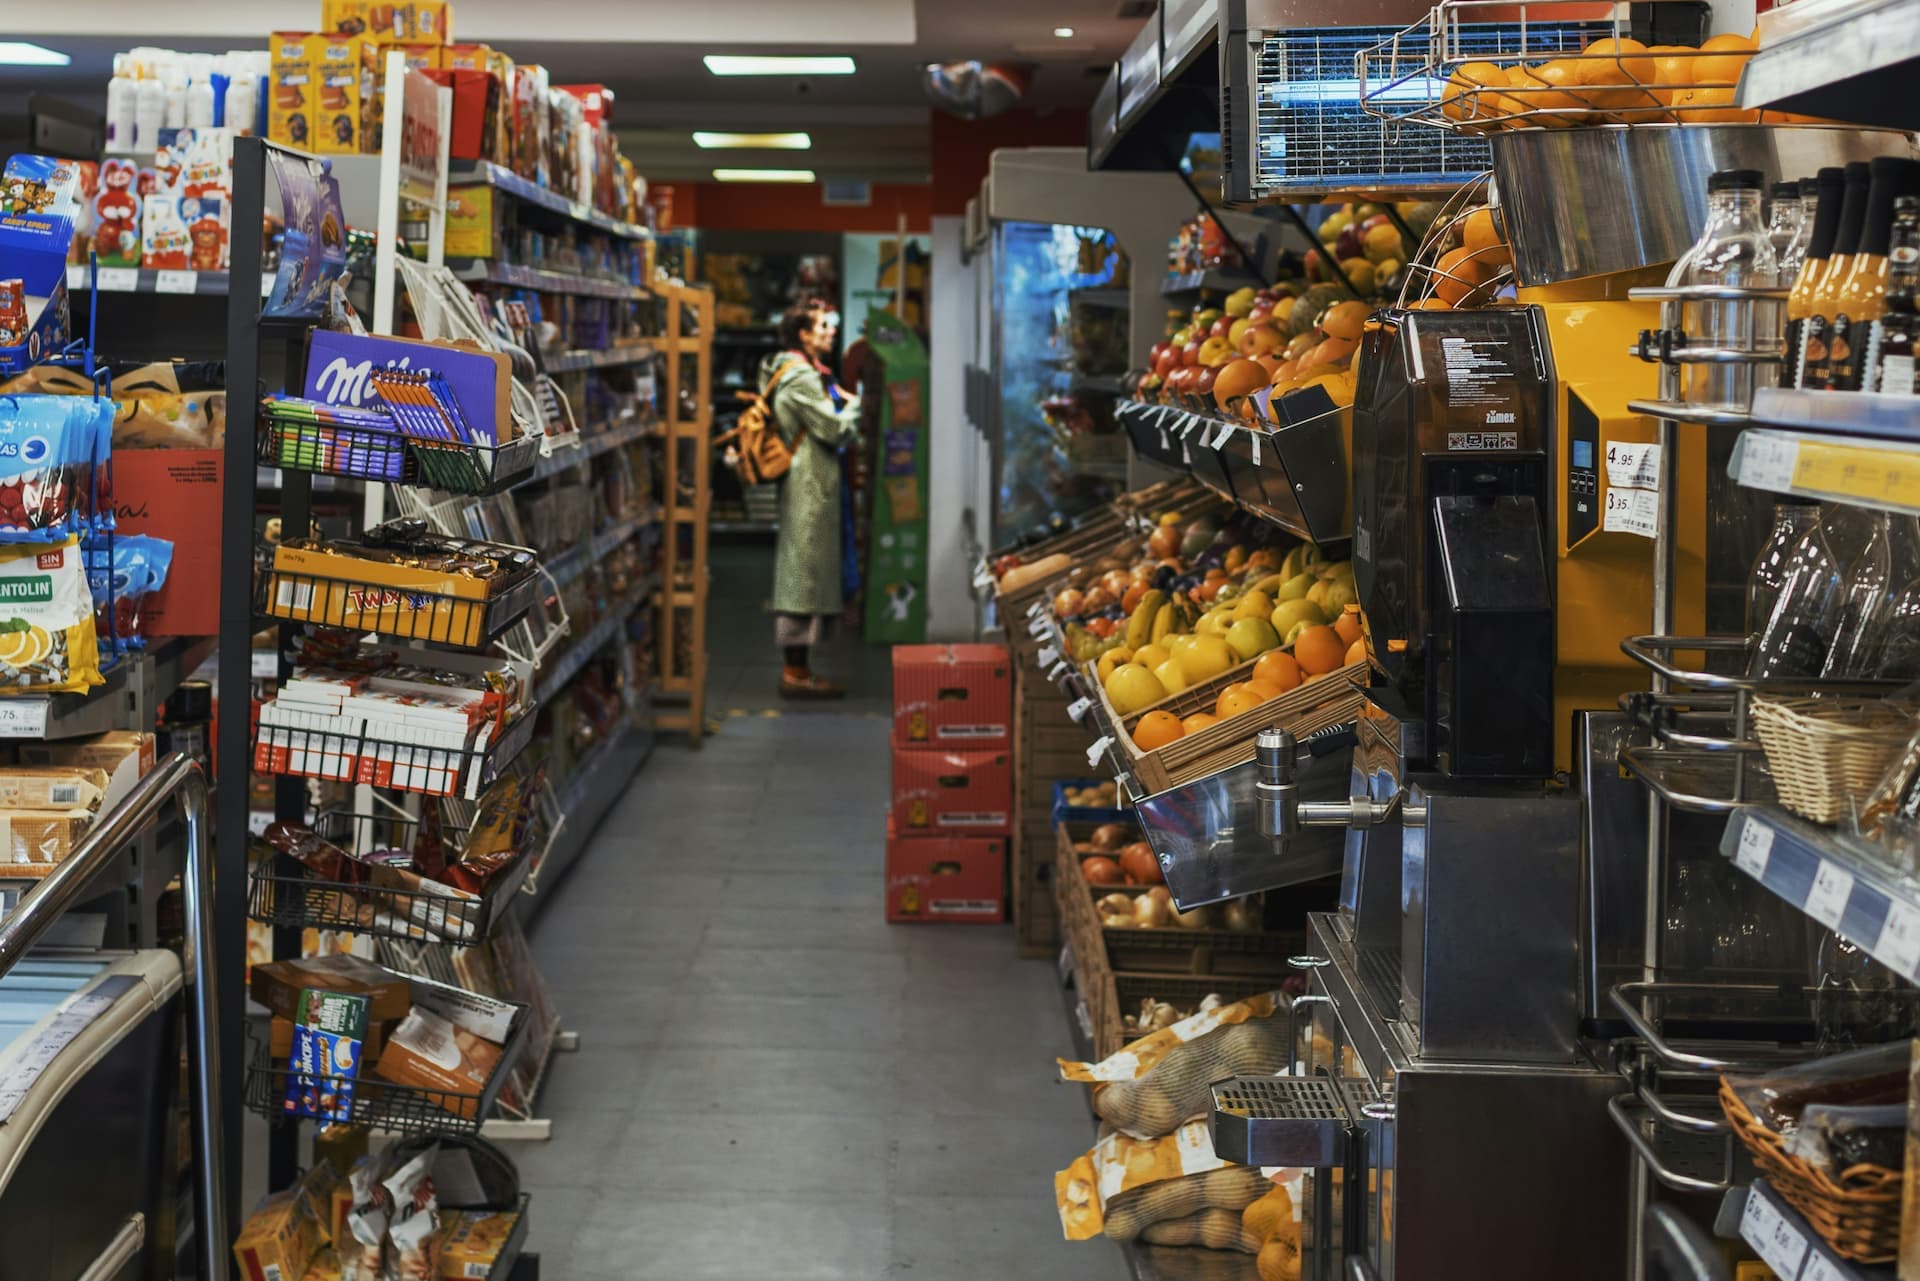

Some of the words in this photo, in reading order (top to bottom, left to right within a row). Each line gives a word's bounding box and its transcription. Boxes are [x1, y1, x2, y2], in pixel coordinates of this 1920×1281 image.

[0, 444, 17, 457] AS
[1608, 446, 1633, 466] 4.95
[41, 554, 60, 564] SIN
[0, 582, 49, 597] NTOLIN
